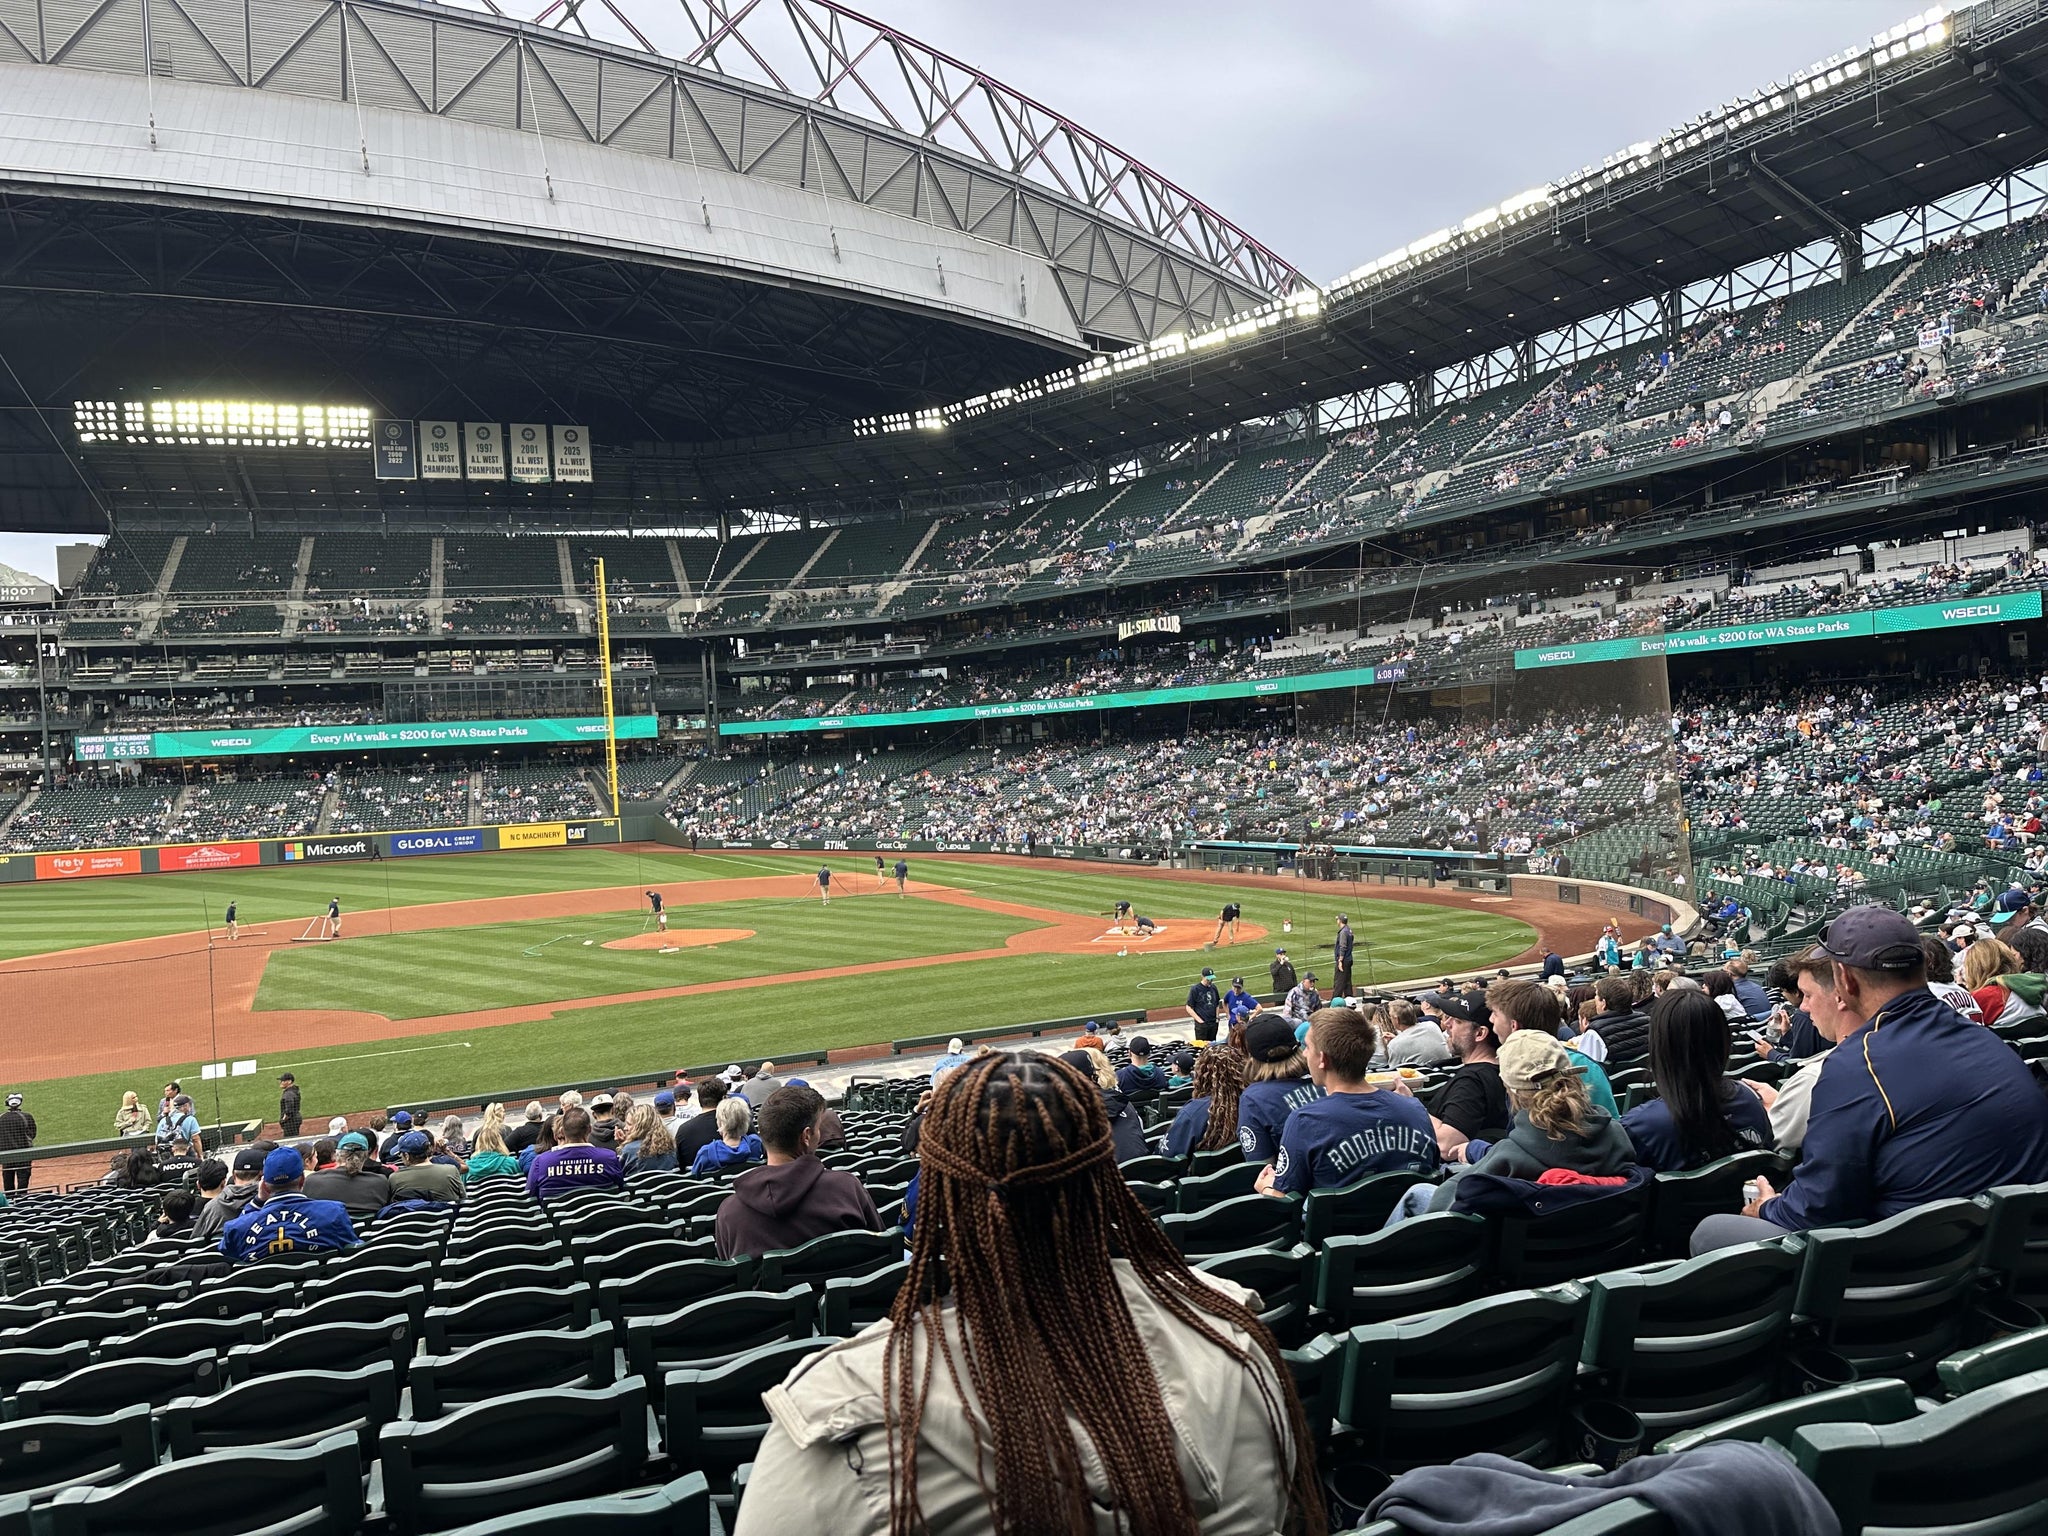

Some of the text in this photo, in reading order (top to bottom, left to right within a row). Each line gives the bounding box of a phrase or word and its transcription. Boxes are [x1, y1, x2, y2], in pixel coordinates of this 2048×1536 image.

[431, 442, 449, 452] 1995
[476, 443, 492, 453] 1997
[521, 445, 538, 454] 2001
[564, 446, 580, 455] 2025
[438, 454, 454, 463] WEST
[528, 457, 543, 465] WEST
[571, 458, 585, 466] WEST
[424, 465, 459, 473] CHAMPIONS
[468, 466, 503, 474] CHAMPIONS
[514, 467, 547, 475] CHAMPIONS
[558, 468, 589, 476] CHAMPIONS
[1942, 604, 2000, 620] WSECU
[1157, 615, 1181, 634] CLUB
[1641, 640, 1667, 652] Every
[1685, 635, 1709, 646] walk
[1718, 631, 1746, 645] $200
[1748, 629, 1764, 640] for
[1765, 627, 1785, 639] WA
[1786, 625, 1816, 636] State
[1817, 621, 1850, 633] Parks
[1538, 651, 1575, 662] WSECU
[1377, 668, 1405, 679] 6:08 PM
[975, 708, 990, 717] Every
[1001, 705, 1015, 714] walk
[1020, 704, 1036, 713] $200
[1036, 703, 1045, 711] for
[1046, 702, 1059, 710] WA
[1059, 700, 1075, 708] State
[1075, 699, 1094, 707] Parks
[576, 725, 612, 733] WSECU
[310, 733, 341, 745] Every
[364, 731, 389, 741] walk
[400, 729, 429, 741] $200
[430, 728, 447, 739] for
[448, 728, 468, 738] WA
[469, 727, 497, 737] State
[498, 726, 528, 736] Parks
[211, 738, 251, 746] WSECU
[113, 745, 149, 756] $5,535
[567, 828, 587, 839] CAT
[307, 841, 366, 856] Microsoft
[398, 838, 452, 849] GLOBAL
[824, 841, 848, 850] STIHL
[876, 841, 908, 850] Great Clips
[53, 858, 84, 868] fire tv
[1327, 1119, 1431, 1173] RODRÍGUEZ
[547, 1163, 604, 1177] HUSKIES
[246, 1211, 318, 1245] SEATTLE
